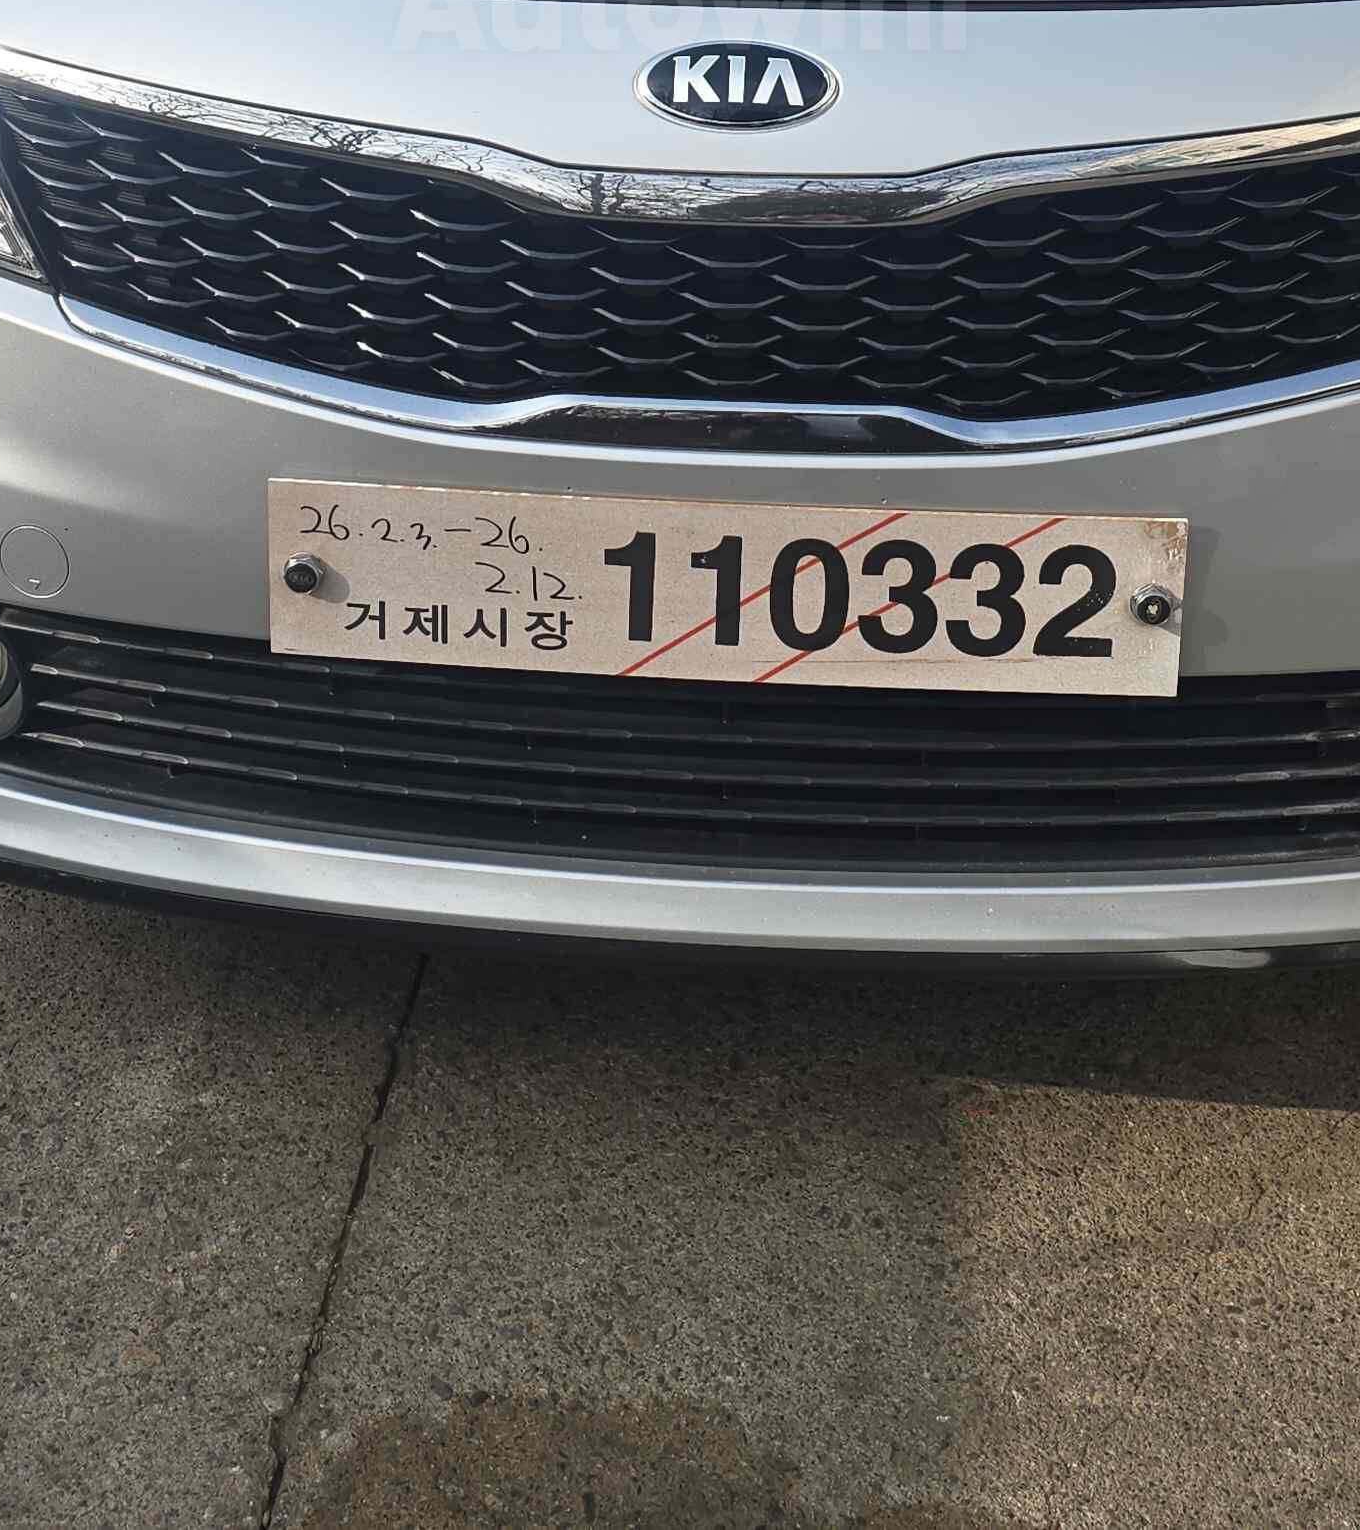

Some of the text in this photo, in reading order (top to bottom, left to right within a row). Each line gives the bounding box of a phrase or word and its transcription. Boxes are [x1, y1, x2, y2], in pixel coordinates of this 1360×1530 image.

[672, 55, 804, 106] KIA
[602, 531, 1115, 659] 110332
[344, 601, 574, 651] 거제시장
